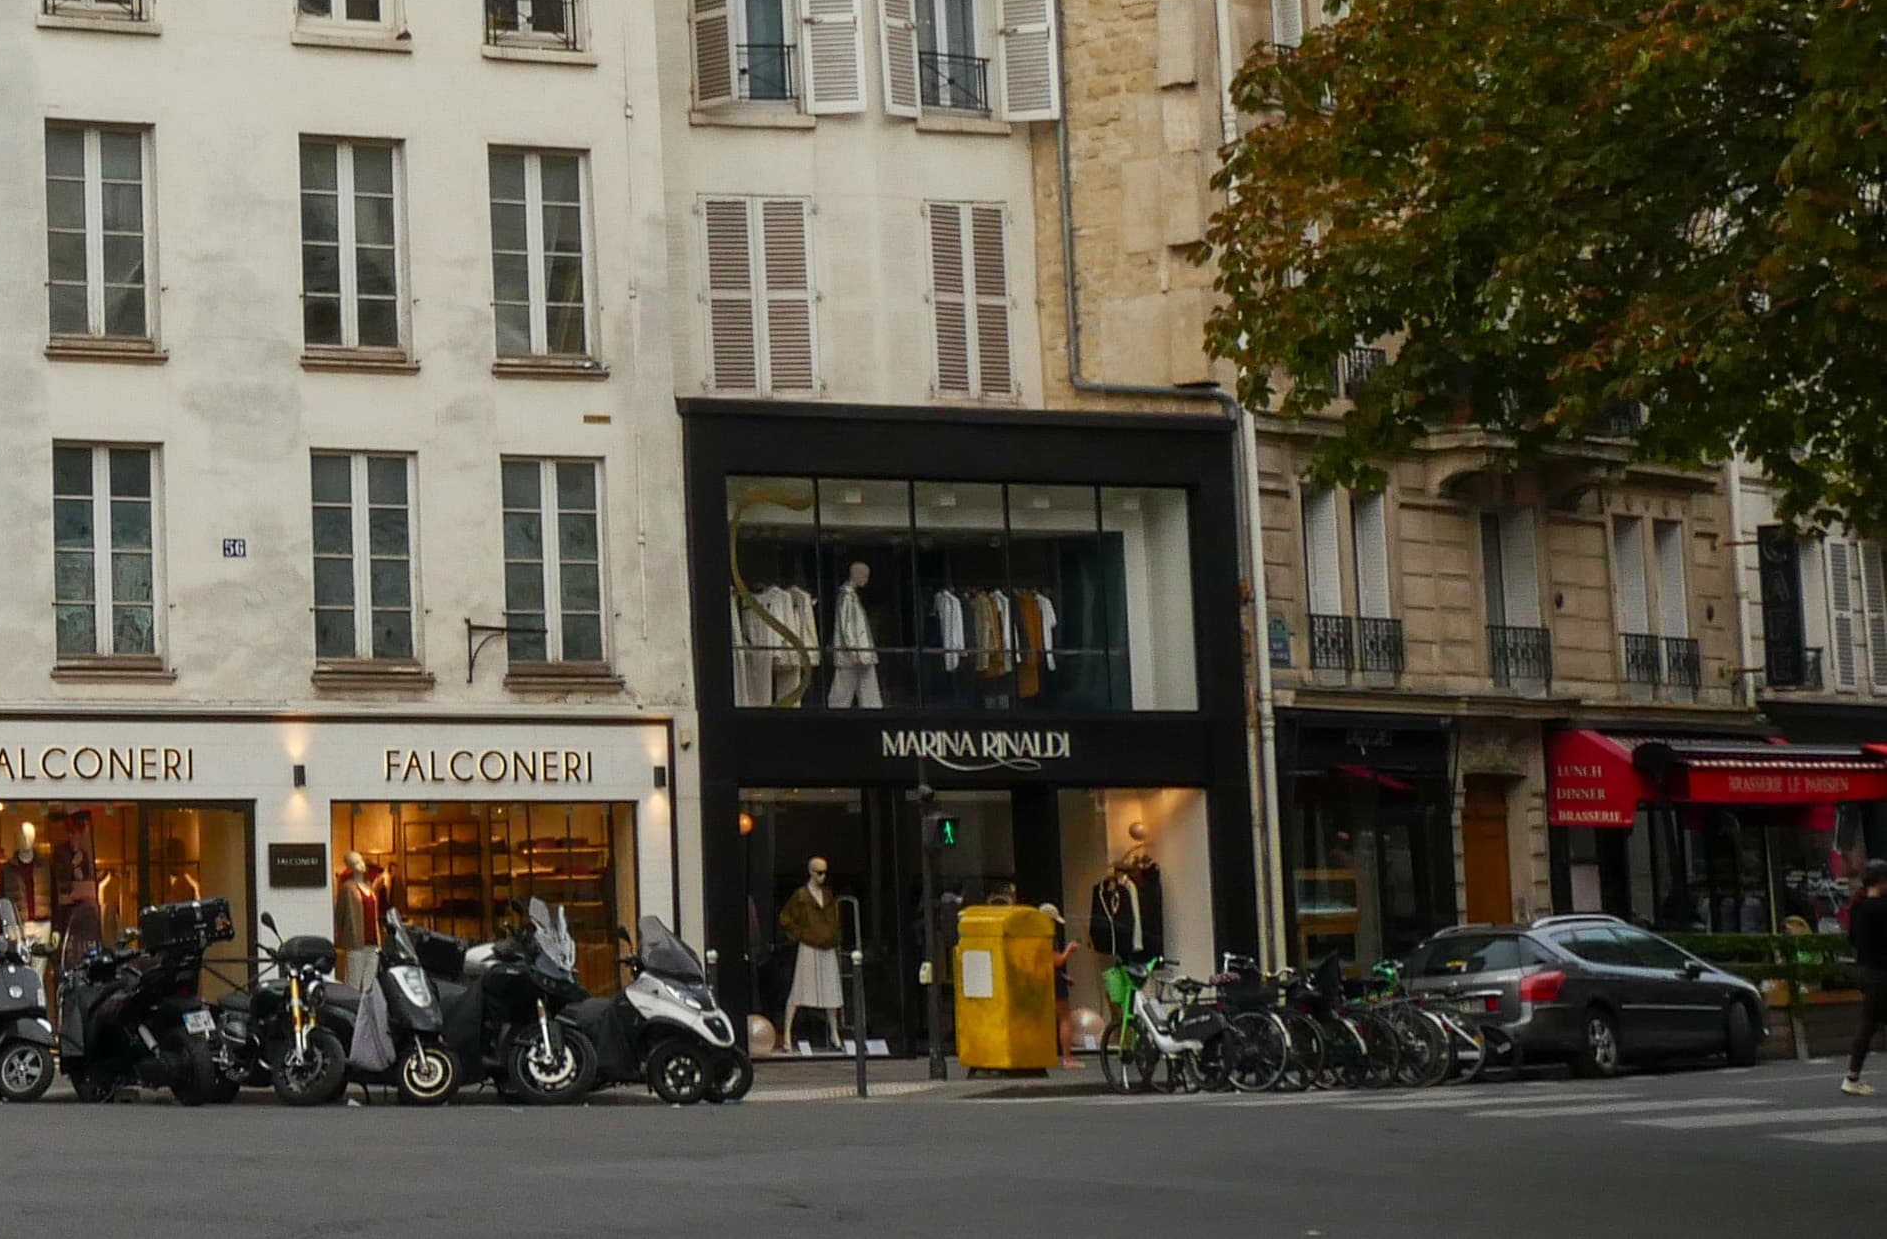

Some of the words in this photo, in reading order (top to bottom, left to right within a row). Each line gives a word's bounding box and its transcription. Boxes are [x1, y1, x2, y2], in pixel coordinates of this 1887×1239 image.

[881, 730, 977, 765] MARINA
[981, 730, 1071, 765] RINALDI
[384, 750, 593, 783] FALCONERI
[1557, 765, 1603, 778] LUNCH
[1728, 776, 1782, 793] BRASSERIE
[1787, 776, 1800, 793] LE
[1805, 776, 1849, 794] PARISIEN
[1557, 787, 1606, 801] DINNER
[1558, 810, 1622, 823] BRASSERIE
